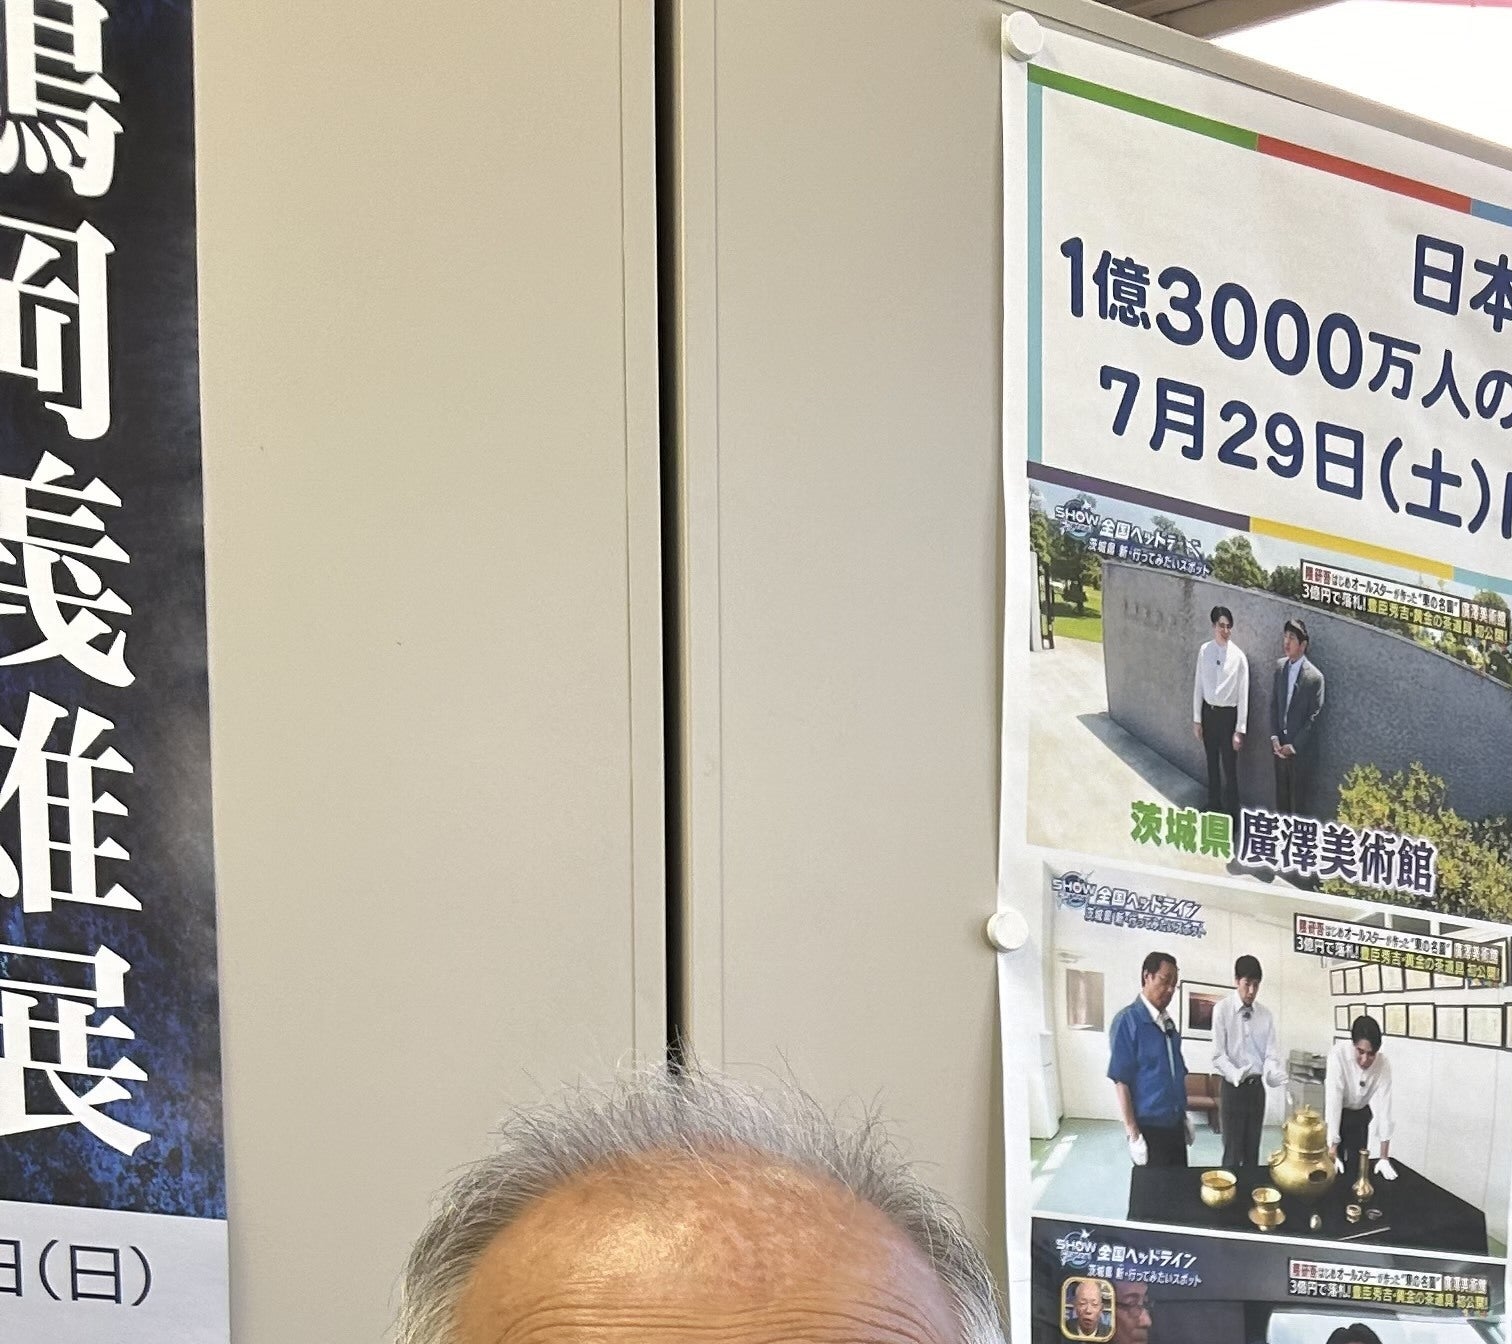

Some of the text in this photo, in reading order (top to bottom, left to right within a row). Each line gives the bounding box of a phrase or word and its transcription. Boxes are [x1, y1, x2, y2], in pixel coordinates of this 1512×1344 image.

[1054, 505, 1100, 526] SHOW
[1130, 800, 1435, 895] 茨城県 廣澤美術館
[1097, 1244, 1198, 1268] 全国ヘッドライン
